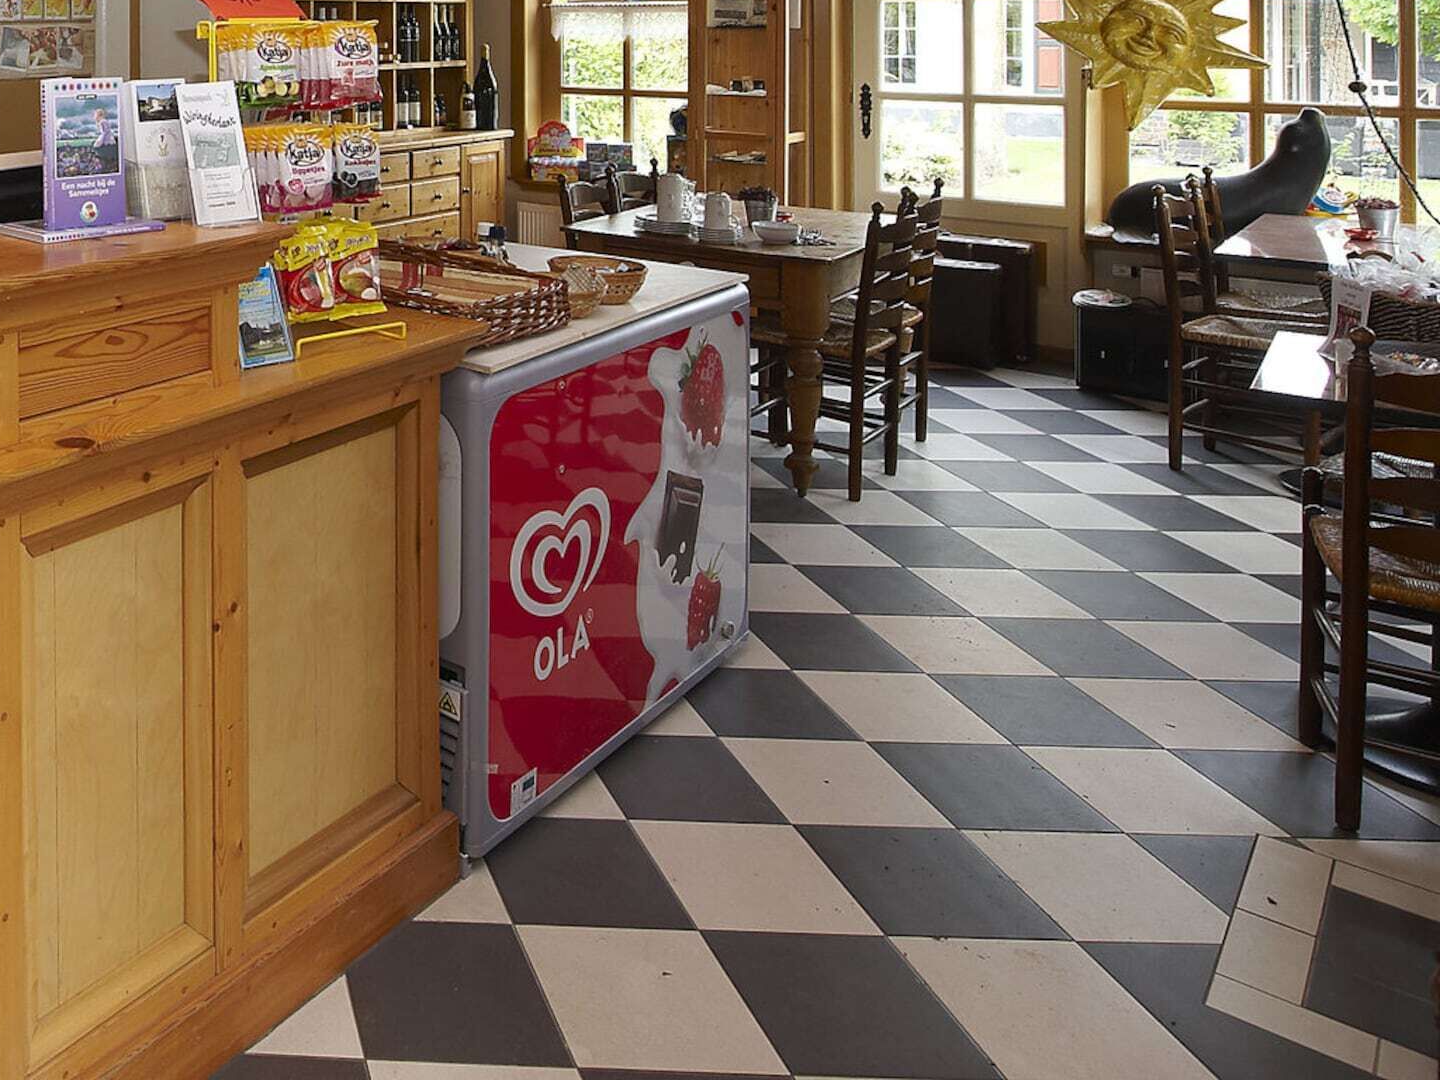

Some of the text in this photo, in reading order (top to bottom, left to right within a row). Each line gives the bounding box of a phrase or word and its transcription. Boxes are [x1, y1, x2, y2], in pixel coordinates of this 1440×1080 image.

[262, 44, 290, 60] Katja
[341, 38, 370, 56] Katja
[289, 145, 320, 161] Katja
[346, 141, 372, 155] Katja
[61, 182, 75, 191] Een
[533, 614, 590, 681] OLA
